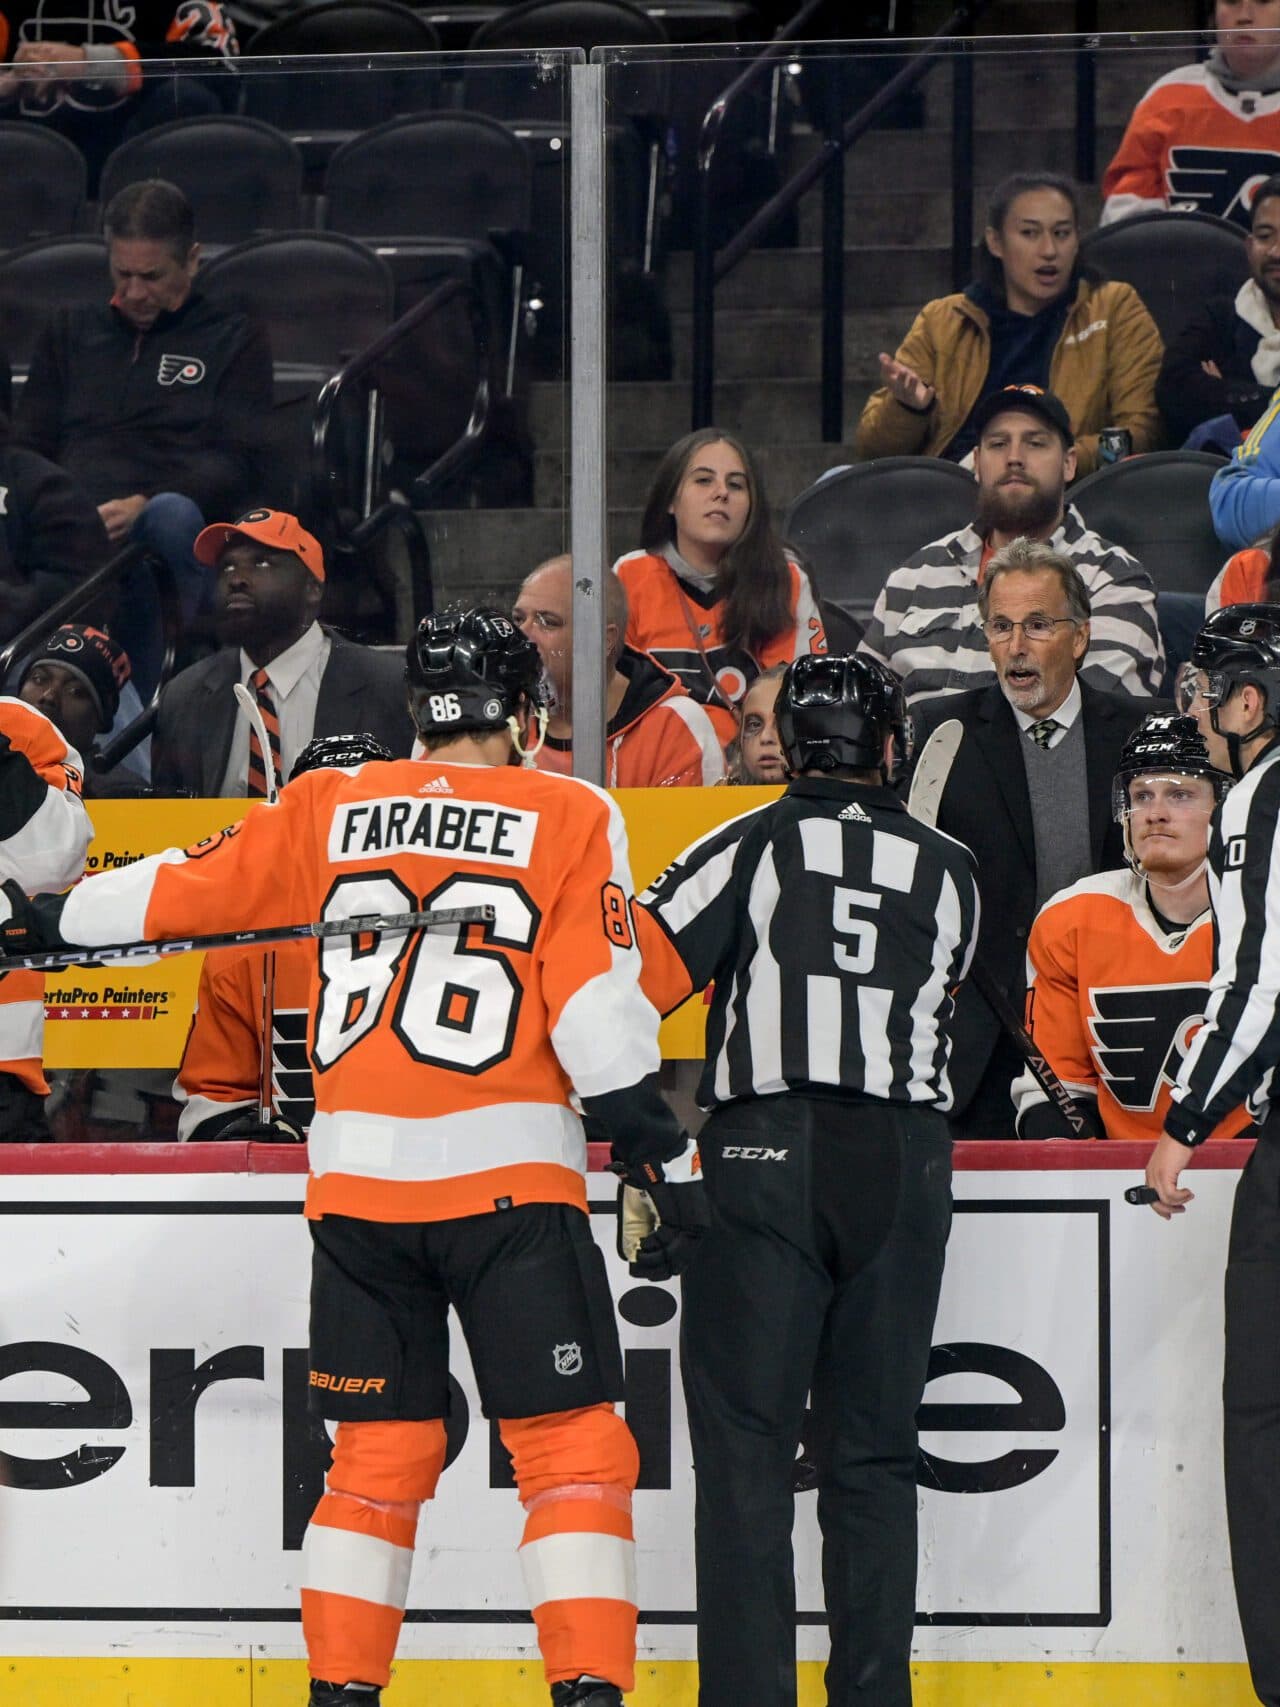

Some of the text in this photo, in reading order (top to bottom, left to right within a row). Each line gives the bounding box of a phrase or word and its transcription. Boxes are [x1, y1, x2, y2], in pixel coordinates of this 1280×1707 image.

[808, 616, 828, 656] 2
[429, 693, 462, 722] 86
[322, 752, 364, 762] CCM
[1135, 743, 1174, 753] CCM
[341, 801, 522, 857] FARABEE
[837, 812, 872, 823] adidas
[1224, 839, 1247, 867] 0
[600, 880, 638, 951] 8
[832, 885, 882, 975] 5
[311, 868, 542, 1077] 86
[44, 986, 169, 1003] ertaPro Painters
[1028, 1055, 1085, 1133] ALPHA
[721, 1146, 789, 1161] CCM
